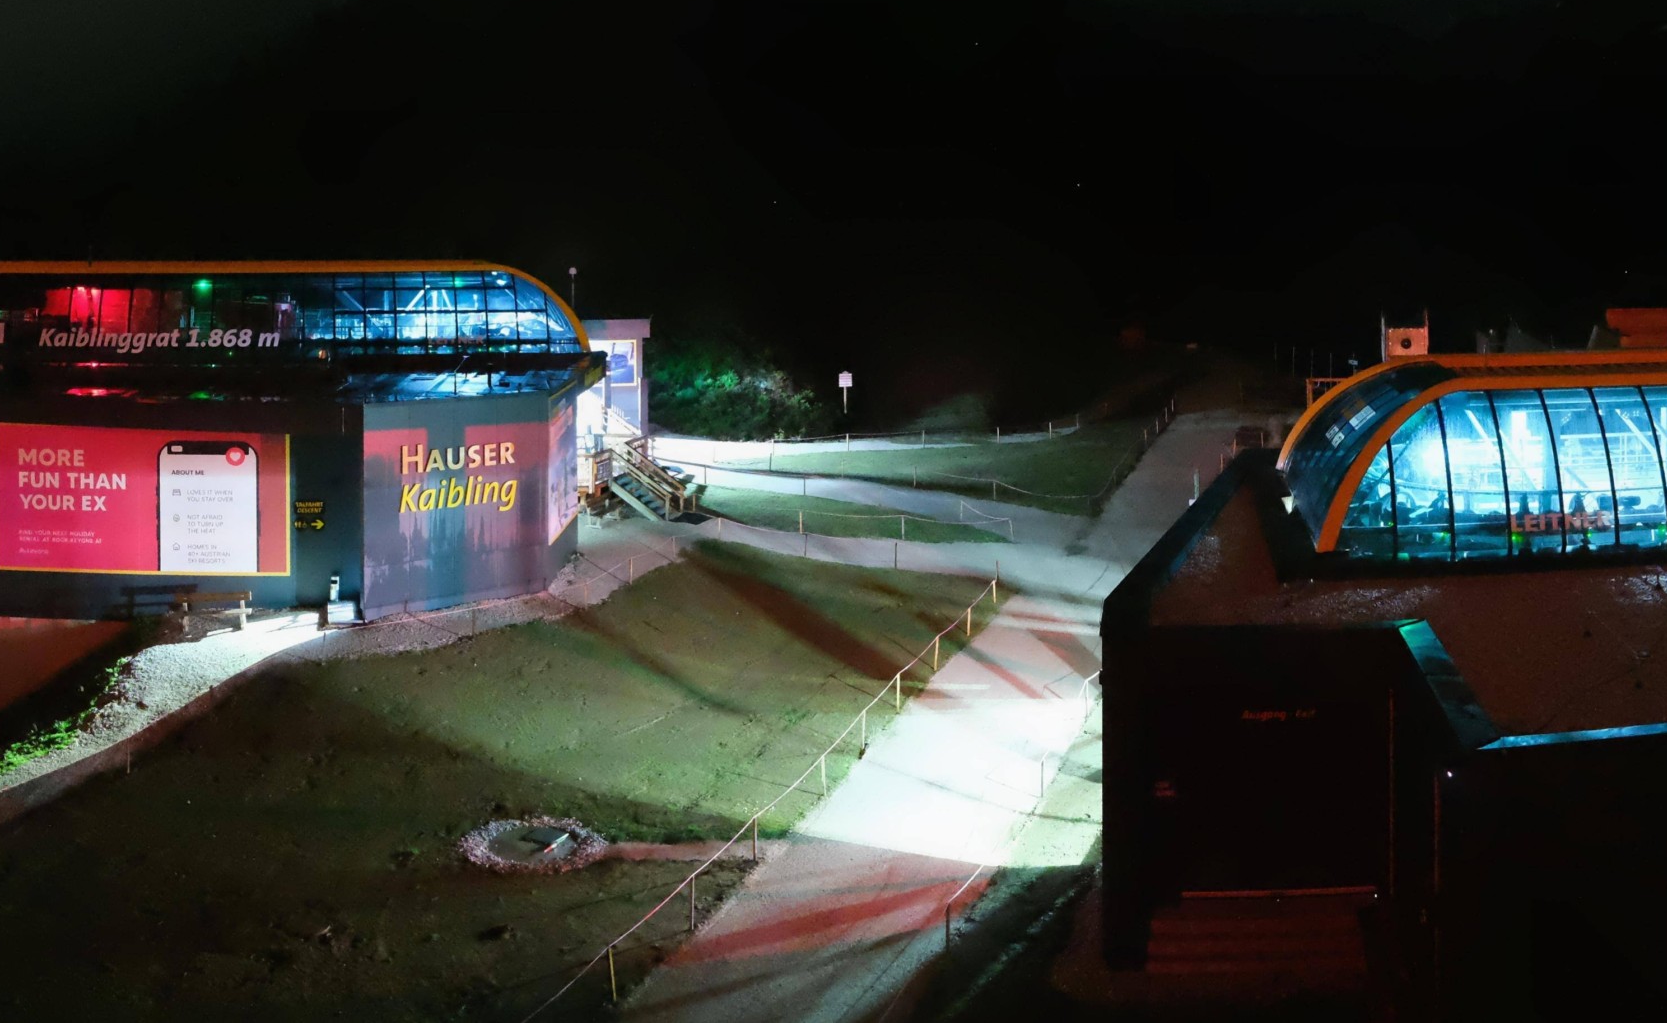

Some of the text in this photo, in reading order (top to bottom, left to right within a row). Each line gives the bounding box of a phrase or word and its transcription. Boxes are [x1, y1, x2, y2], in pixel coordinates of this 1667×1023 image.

[38, 328, 281, 354] Kaiblinggrat 1.868 m
[18, 448, 85, 467] MORE
[400, 442, 516, 475] HAUSER
[18, 472, 127, 490] FUN THAN
[19, 494, 107, 512] YOUR EX
[399, 475, 518, 514] Kaibling
[1510, 511, 1612, 532] LEITNER
